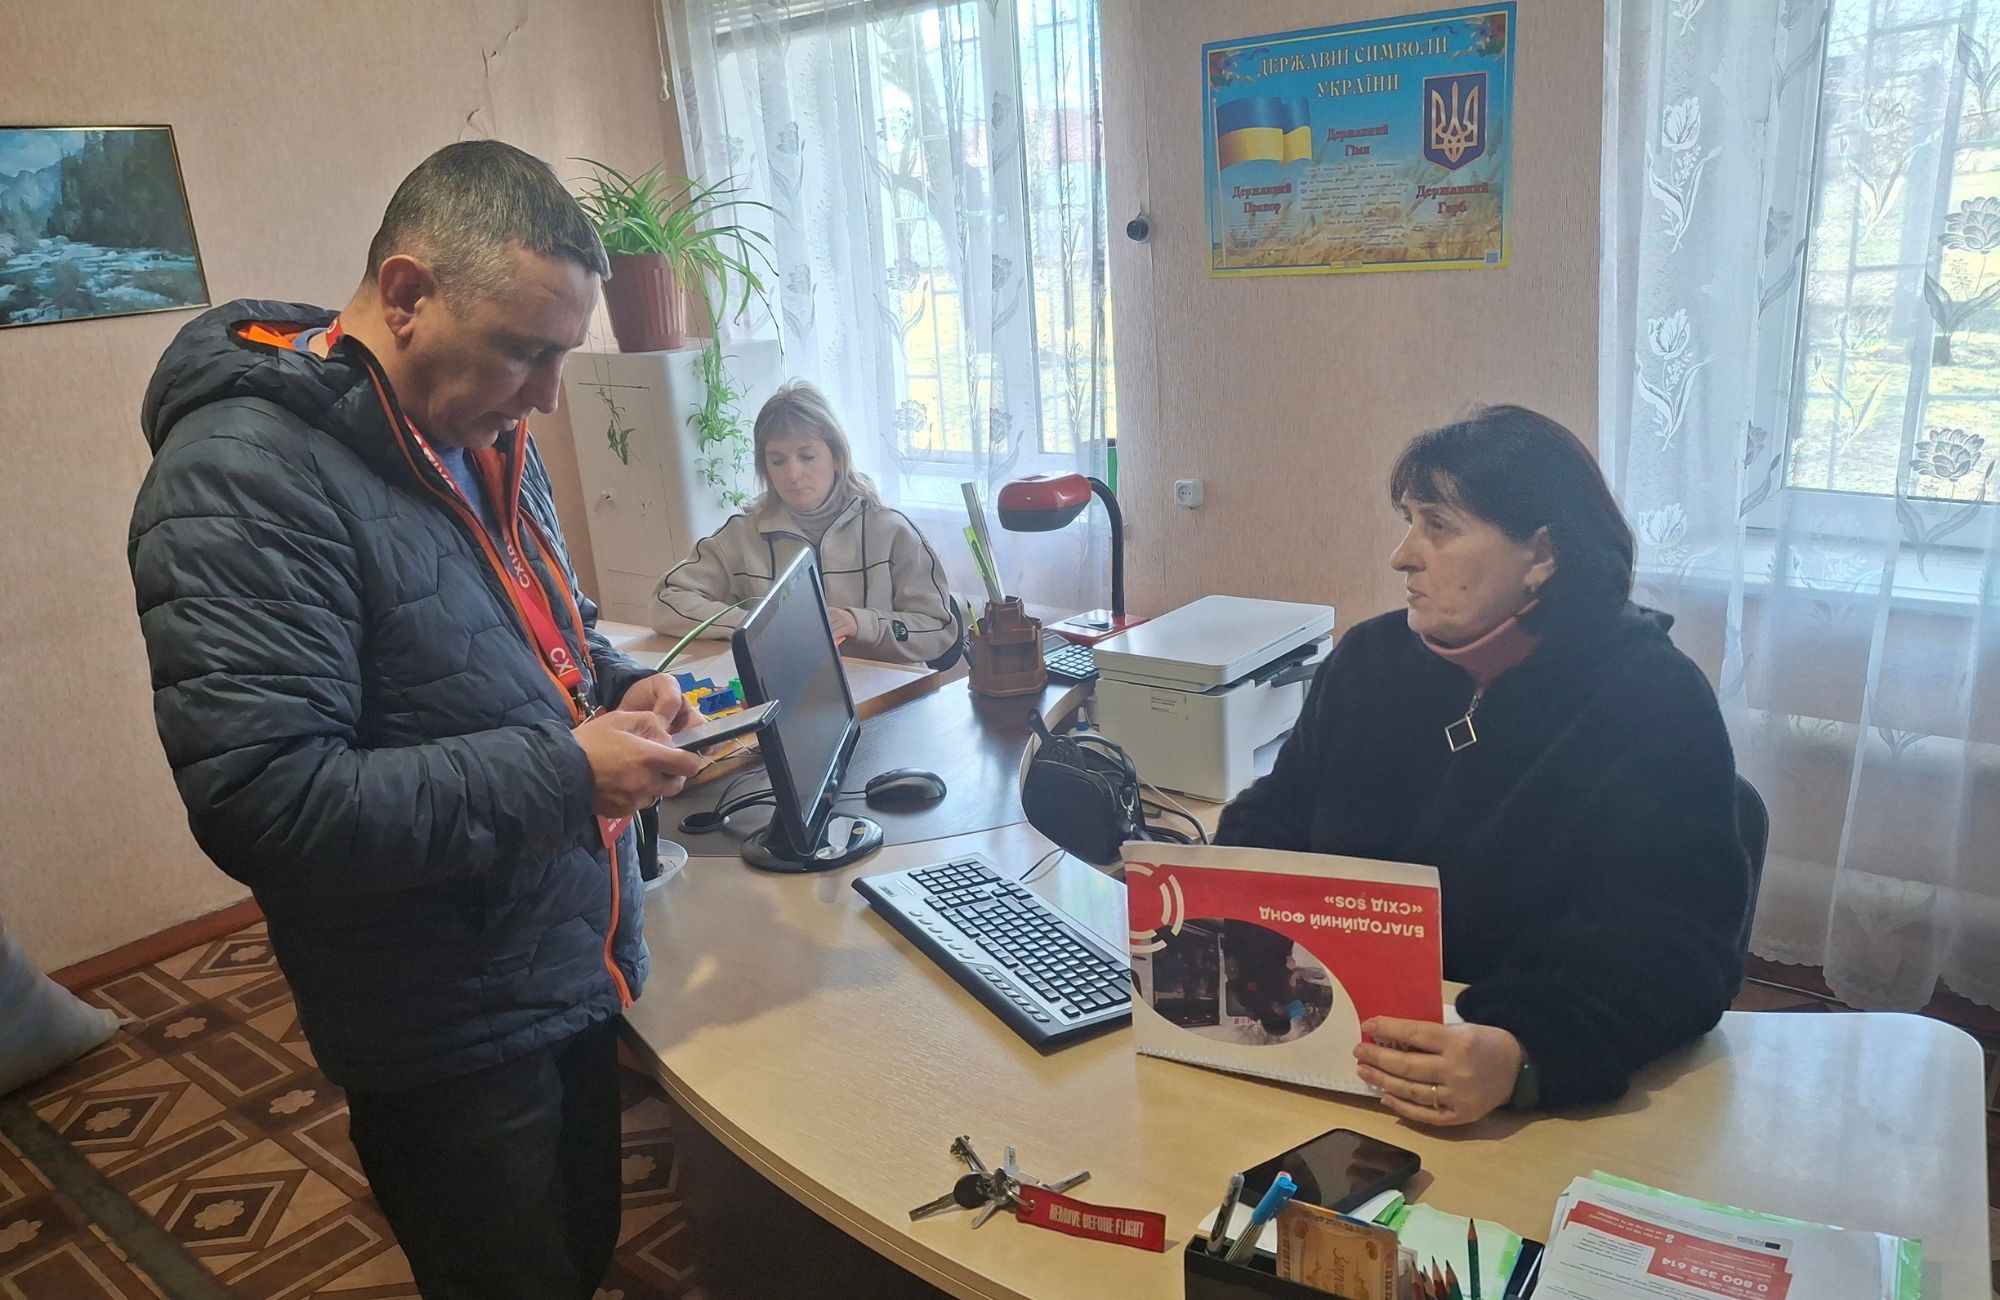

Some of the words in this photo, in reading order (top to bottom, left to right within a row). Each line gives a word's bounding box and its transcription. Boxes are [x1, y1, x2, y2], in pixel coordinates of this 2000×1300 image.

[1257, 45, 1349, 78] ДЕРЖАВНІ
[1354, 36, 1448, 63] СИМВОЛИ
[1317, 73, 1399, 98] УКРАЇНИ
[1258, 906, 1306, 924] ФОНД
[1324, 895, 1367, 910] SOS»
[1370, 897, 1423, 915] «СХІД
[1309, 913, 1425, 938] БЛАГОДІЙНИЙ
[1049, 1203, 1082, 1228] REMOVE
[1083, 1213, 1114, 1234] BEFORE
[1115, 1217, 1145, 1239] FLIGHT
